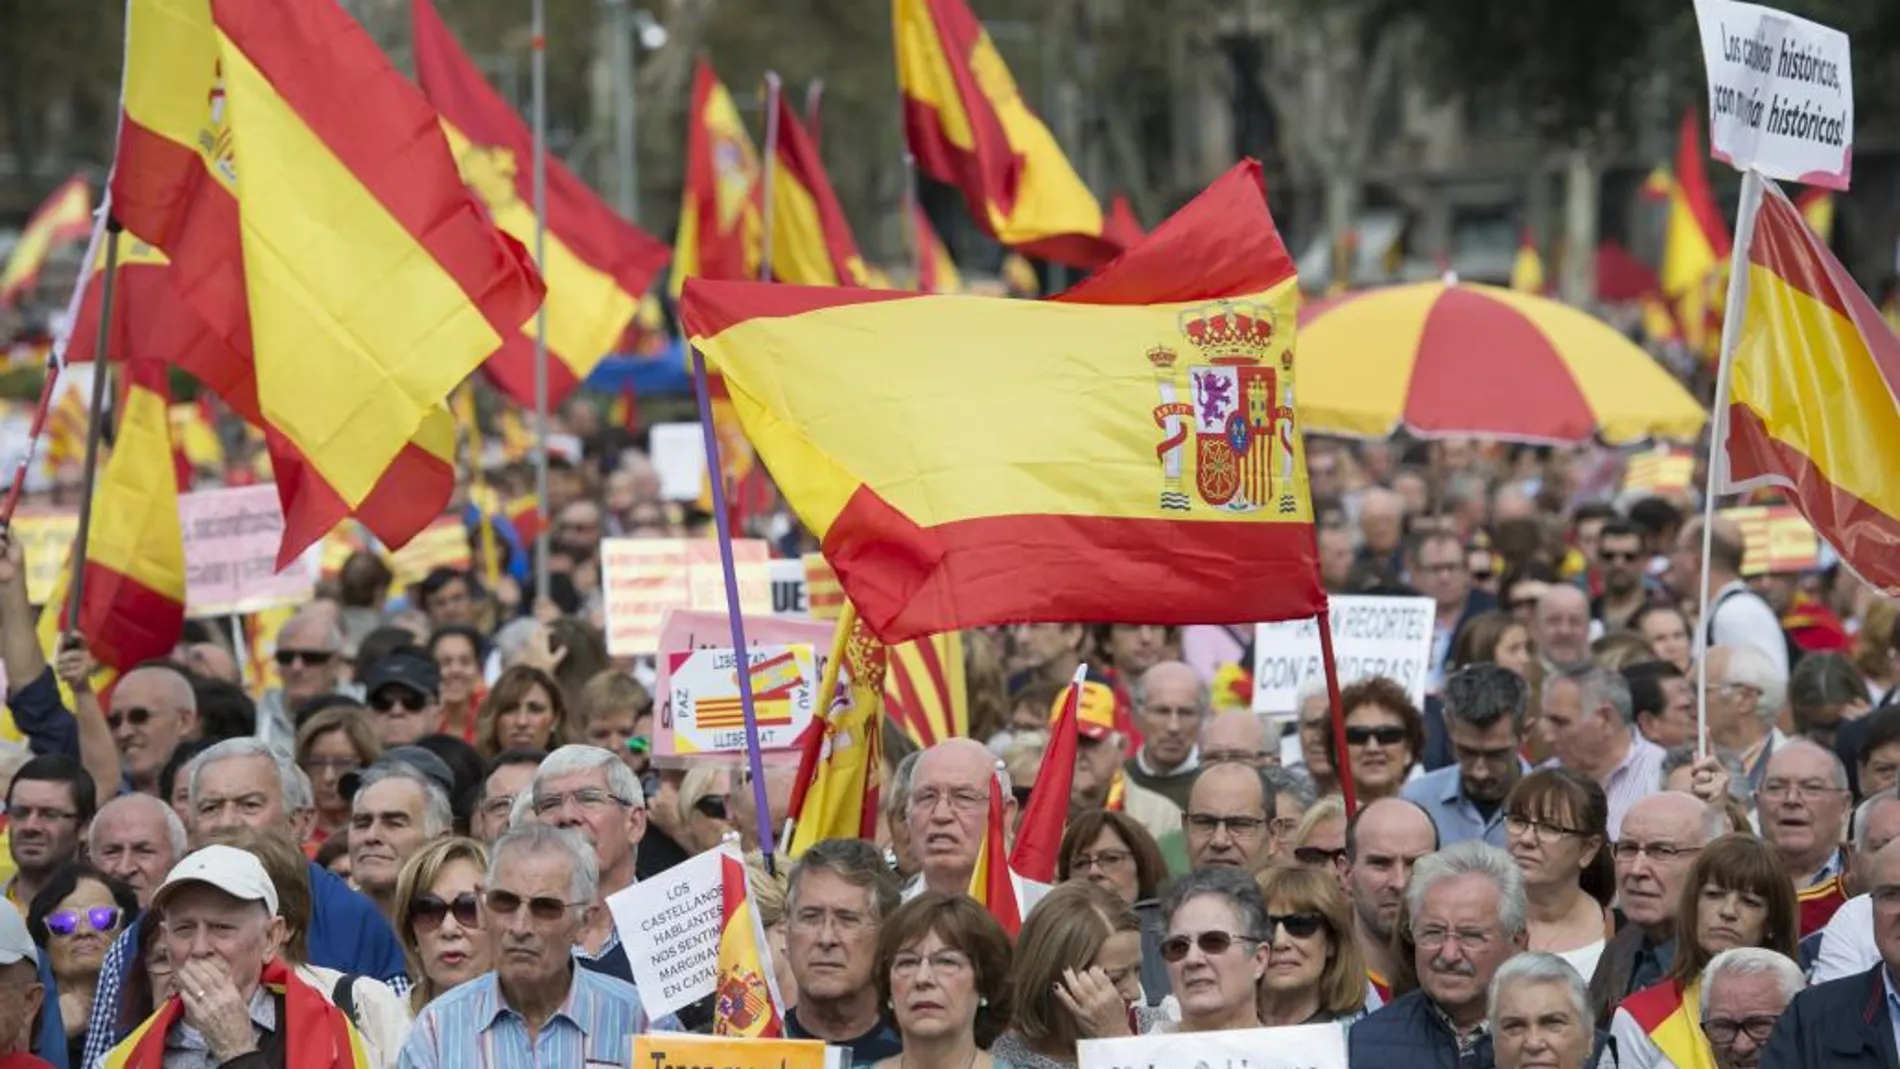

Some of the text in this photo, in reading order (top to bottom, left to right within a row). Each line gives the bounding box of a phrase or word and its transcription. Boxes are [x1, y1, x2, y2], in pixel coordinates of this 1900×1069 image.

[1720, 22, 1741, 63] Los
[712, 653, 768, 670] LIBETAD
[1260, 655, 1302, 690] CON
[676, 688, 690, 718] PAZ
[666, 882, 690, 901] LOS
[653, 904, 724, 946] HABLANTES
[651, 925, 722, 967] NOS SENTIM
[658, 945, 721, 982] MARGINA
[663, 966, 717, 999] EN CATAL
